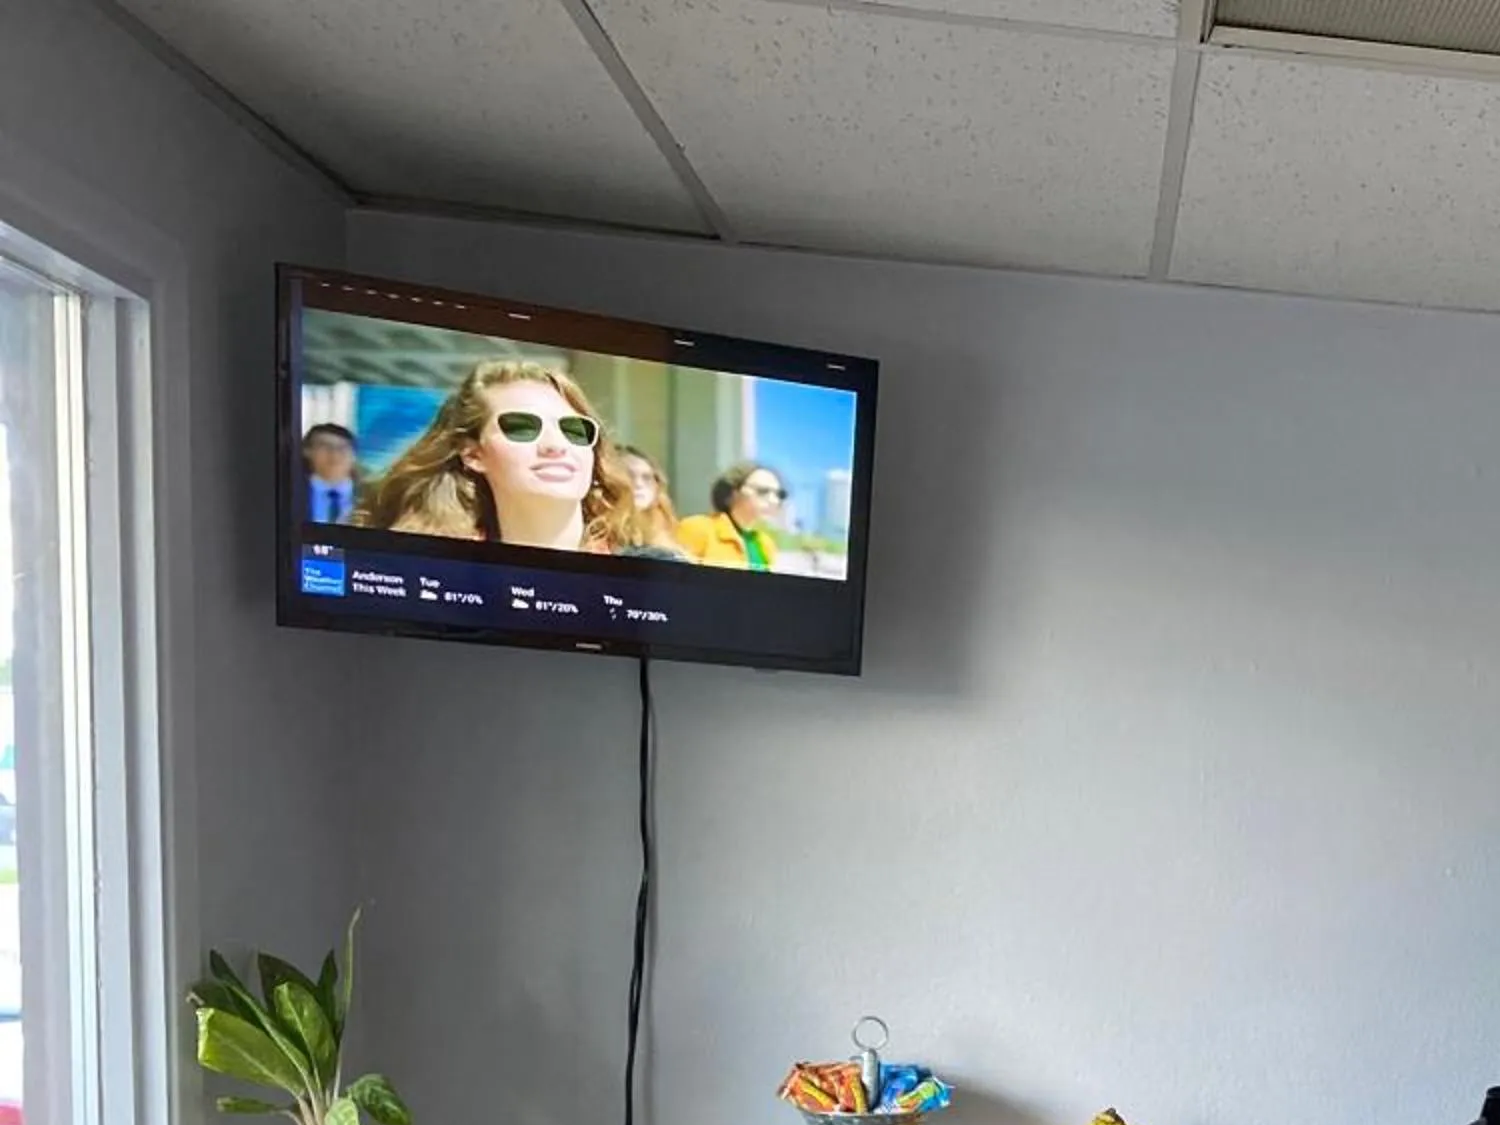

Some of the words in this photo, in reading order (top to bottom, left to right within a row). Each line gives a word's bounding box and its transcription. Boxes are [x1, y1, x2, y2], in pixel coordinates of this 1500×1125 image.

[420, 576, 440, 588] Tue
[511, 586, 535, 598] Wed
[603, 594, 623, 607] Thu
